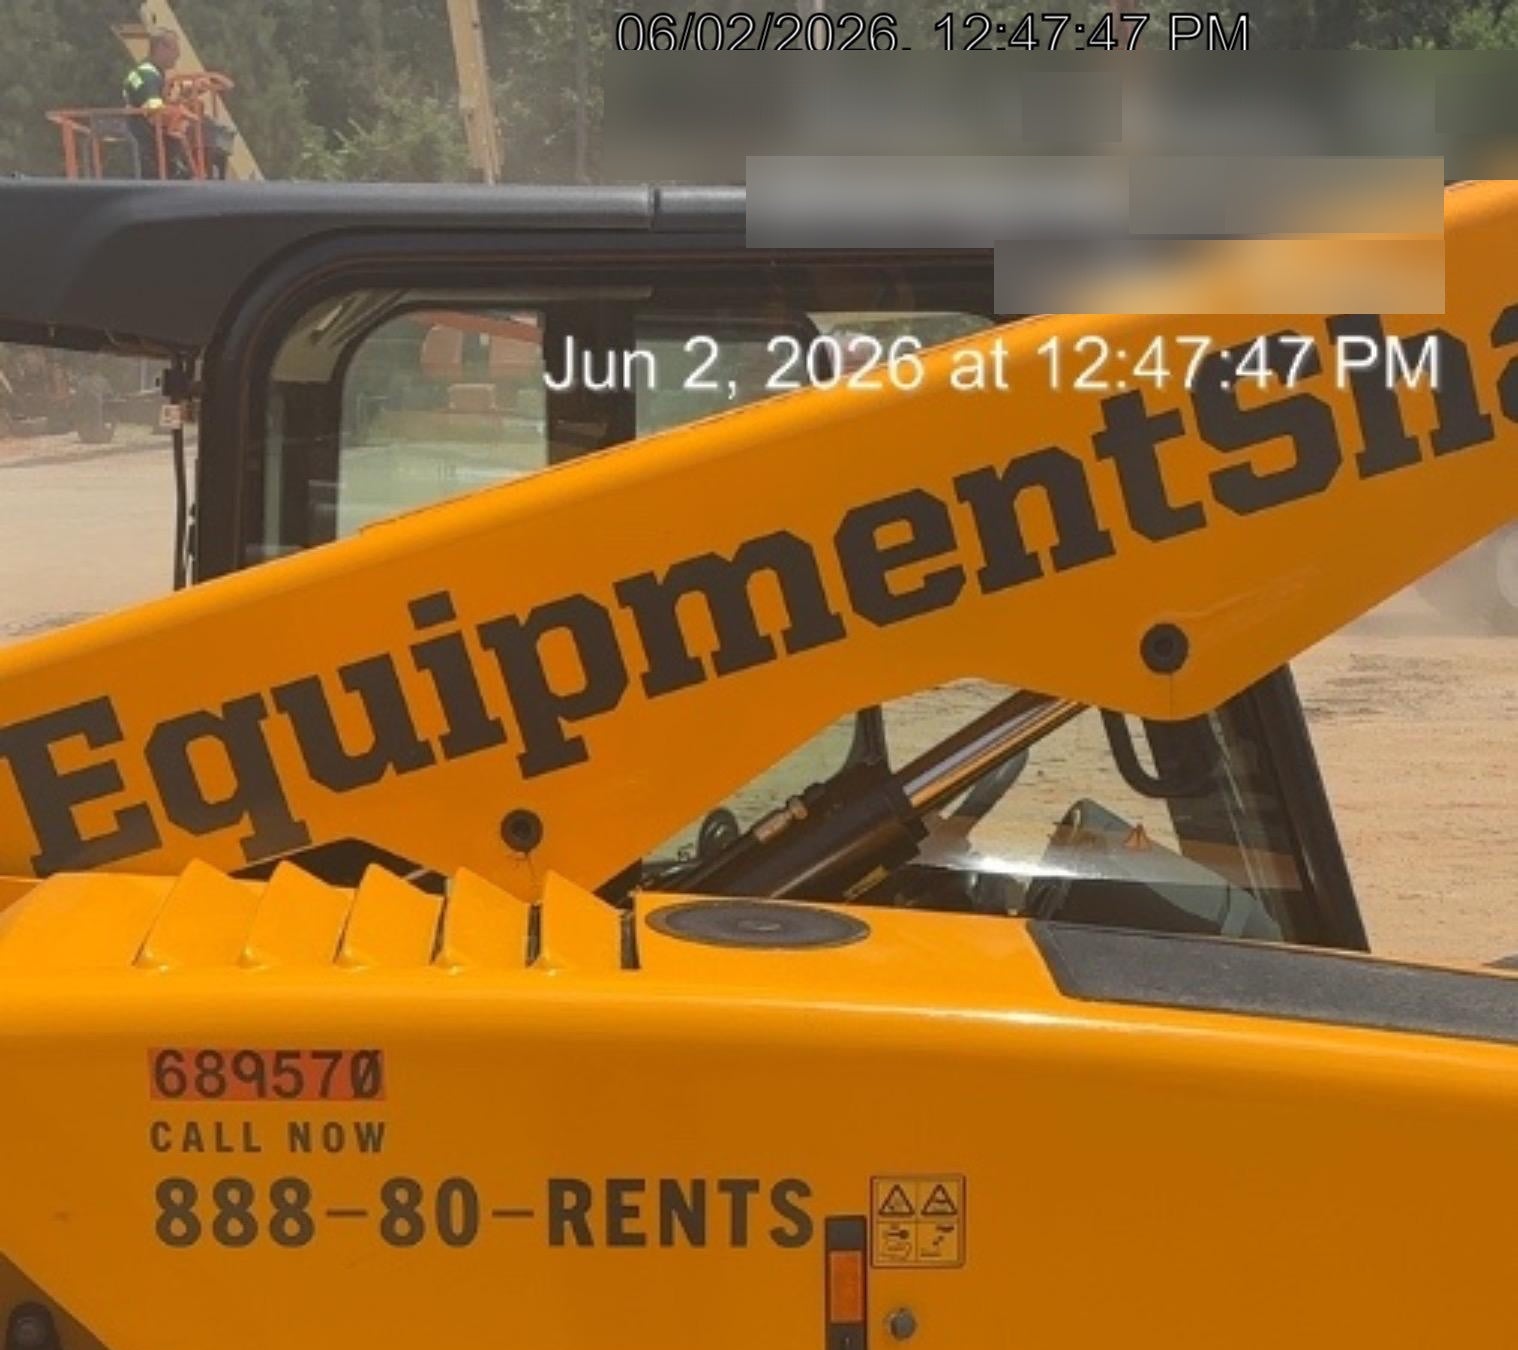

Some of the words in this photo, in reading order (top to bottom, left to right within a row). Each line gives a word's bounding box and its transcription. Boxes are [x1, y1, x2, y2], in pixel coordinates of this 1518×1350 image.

[0, 301, 1518, 878] EquipmentSh
[150, 1121, 262, 1153] CALL
[288, 1121, 386, 1153] NOW
[155, 1176, 814, 1248] 888-80-RENTS
